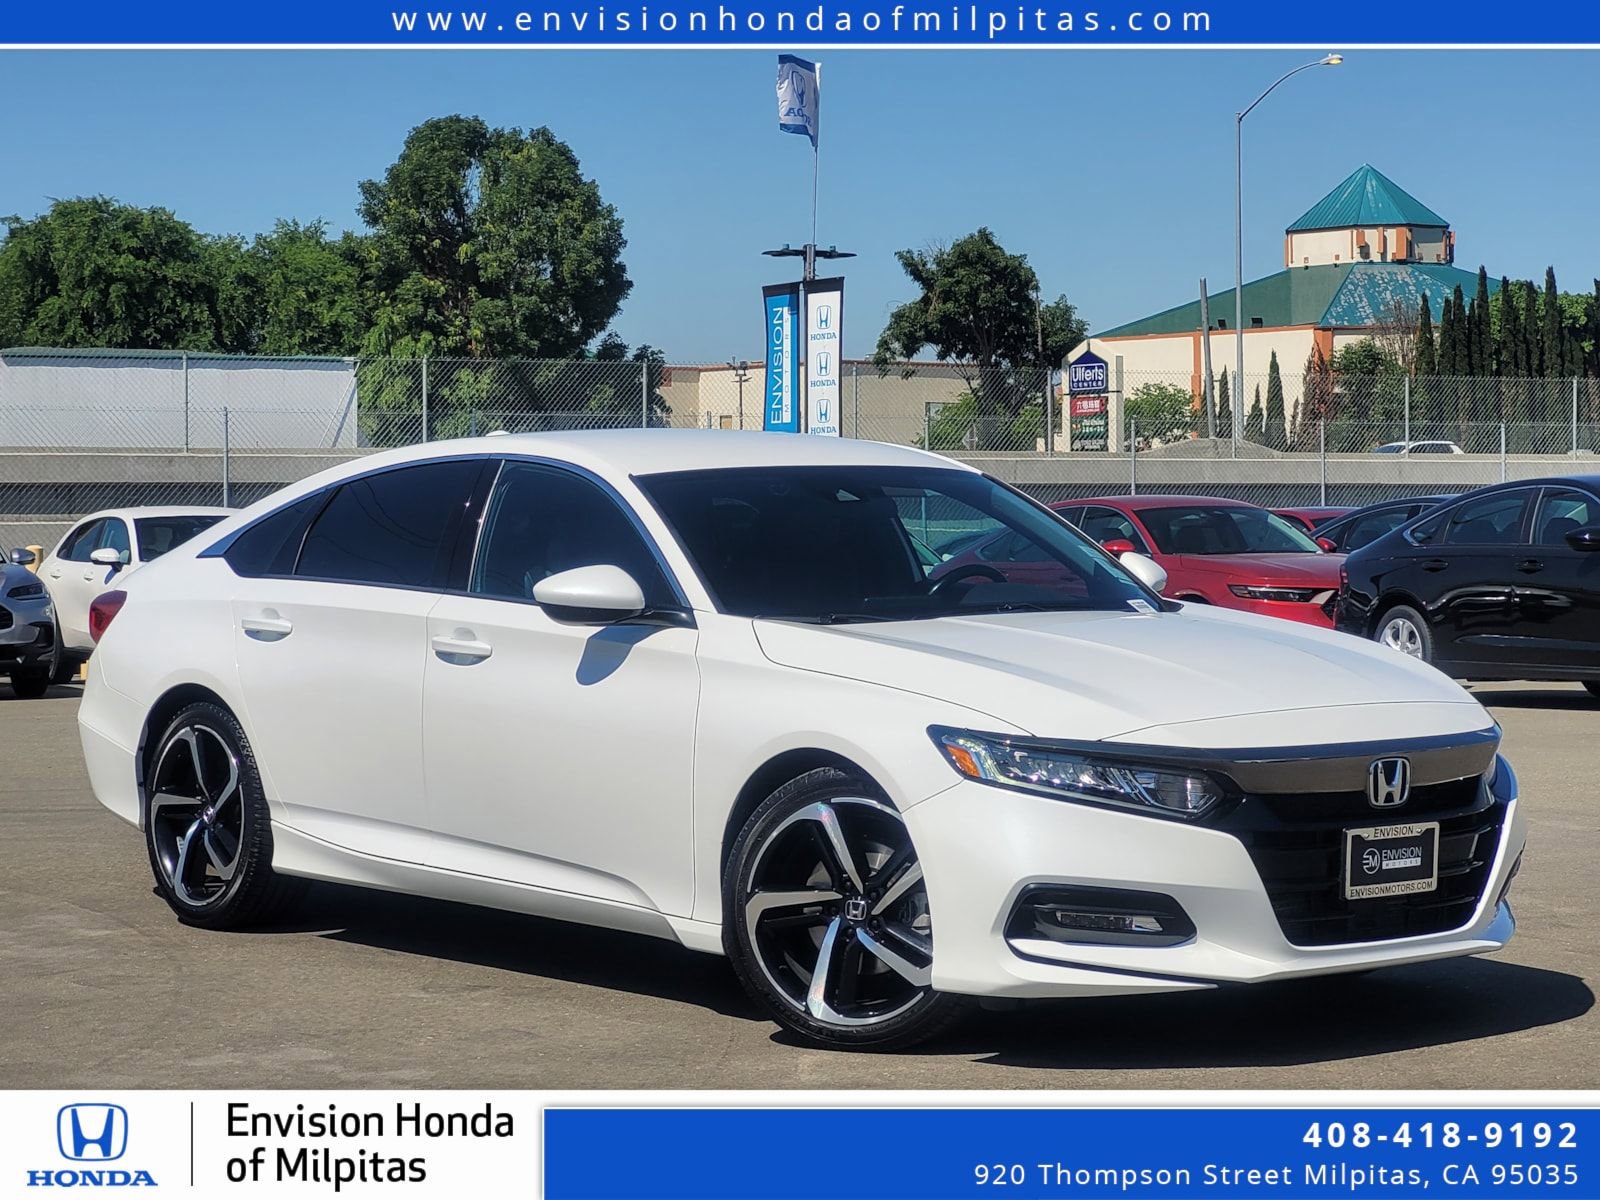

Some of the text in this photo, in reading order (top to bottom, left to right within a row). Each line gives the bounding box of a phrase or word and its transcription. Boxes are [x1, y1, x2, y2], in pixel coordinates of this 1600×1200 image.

[810, 332, 837, 341] HONDA
[771, 307, 783, 424] ENVISION
[1072, 366, 1104, 382] Ulferts
[810, 379, 837, 387] HONDA
[810, 426, 837, 434] HONDA
[1374, 826, 1414, 838] ENVISION
[1382, 847, 1422, 861] ENVISION
[1350, 881, 1433, 897] ENVISIONMOTORS.COM
